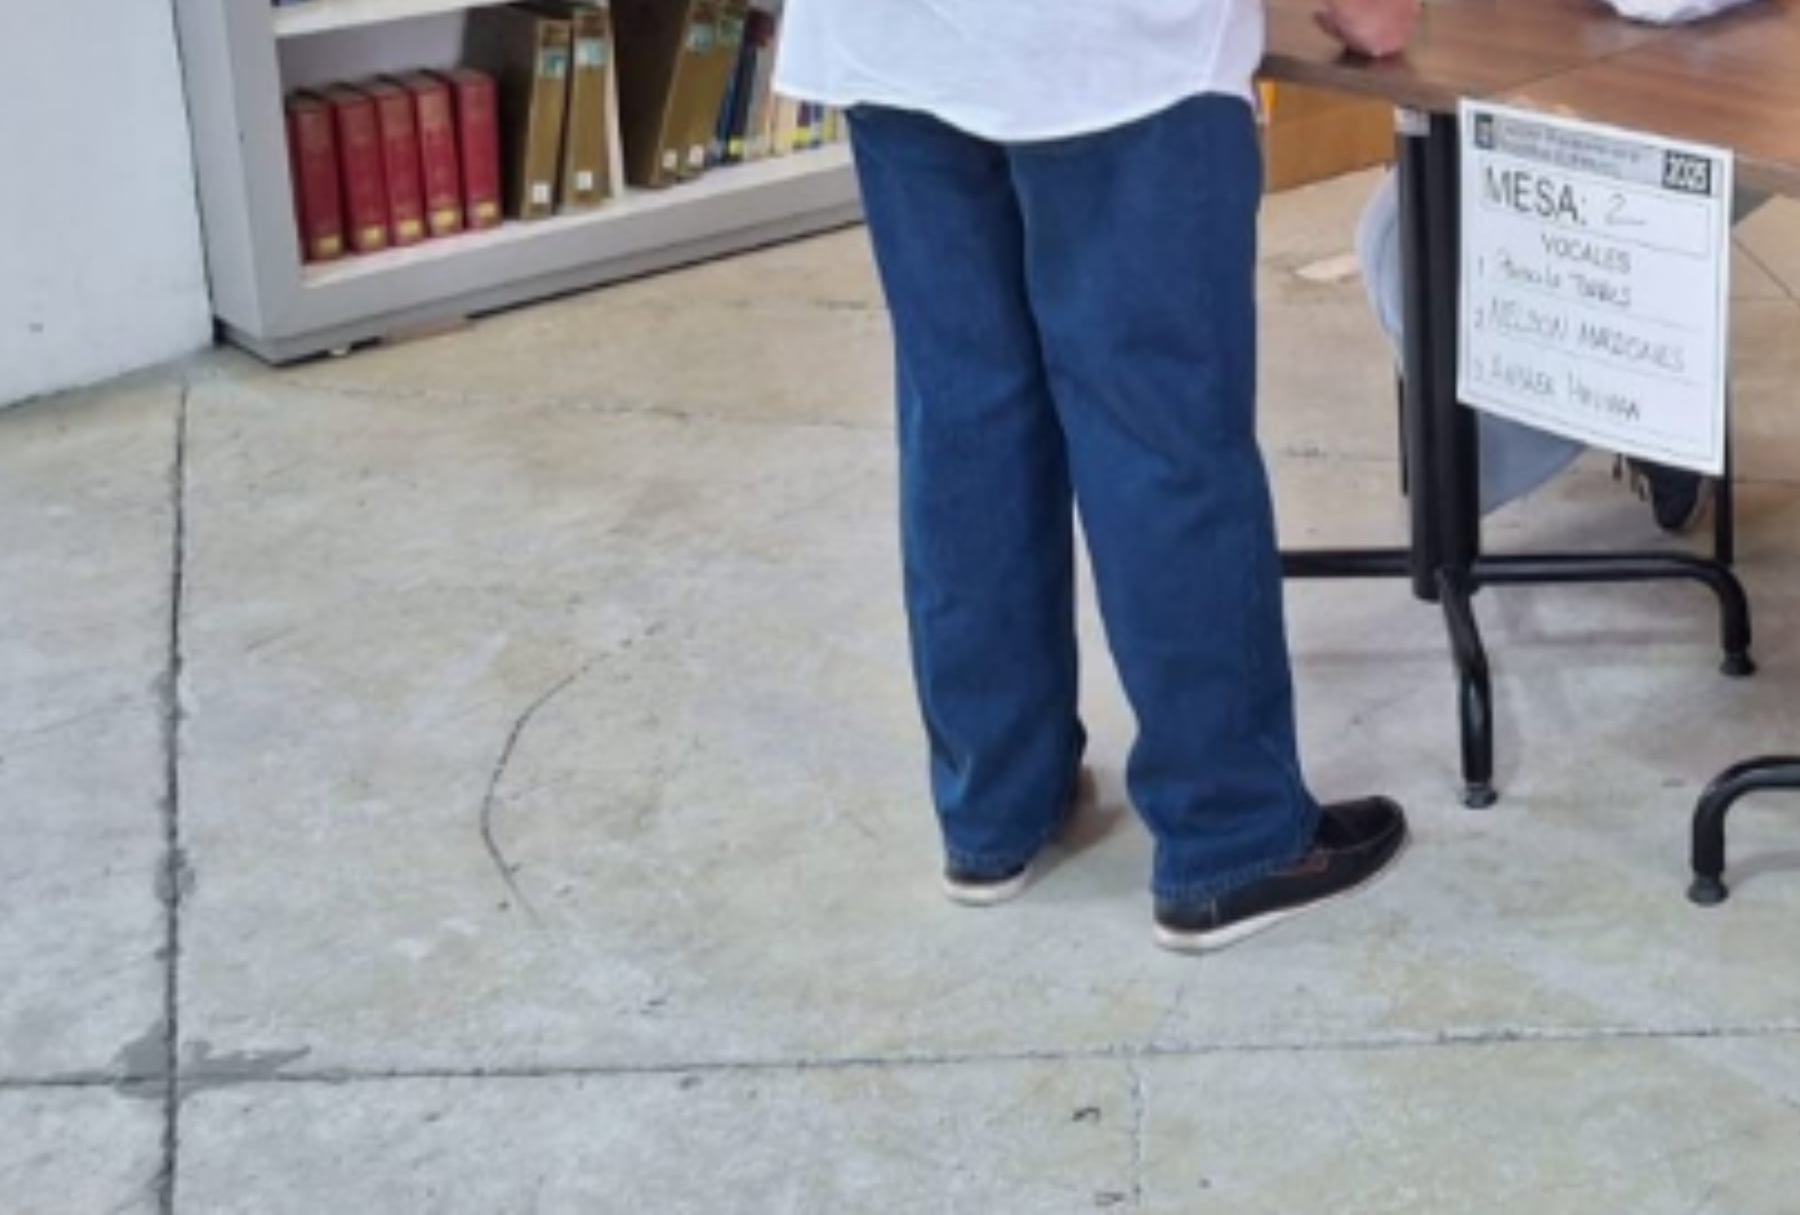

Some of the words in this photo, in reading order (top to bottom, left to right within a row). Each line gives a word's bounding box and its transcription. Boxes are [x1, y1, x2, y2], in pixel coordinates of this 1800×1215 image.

[1485, 165, 1588, 226] MESA:
[1603, 193, 1646, 227] 2
[1541, 233, 1631, 274] VOCALES
